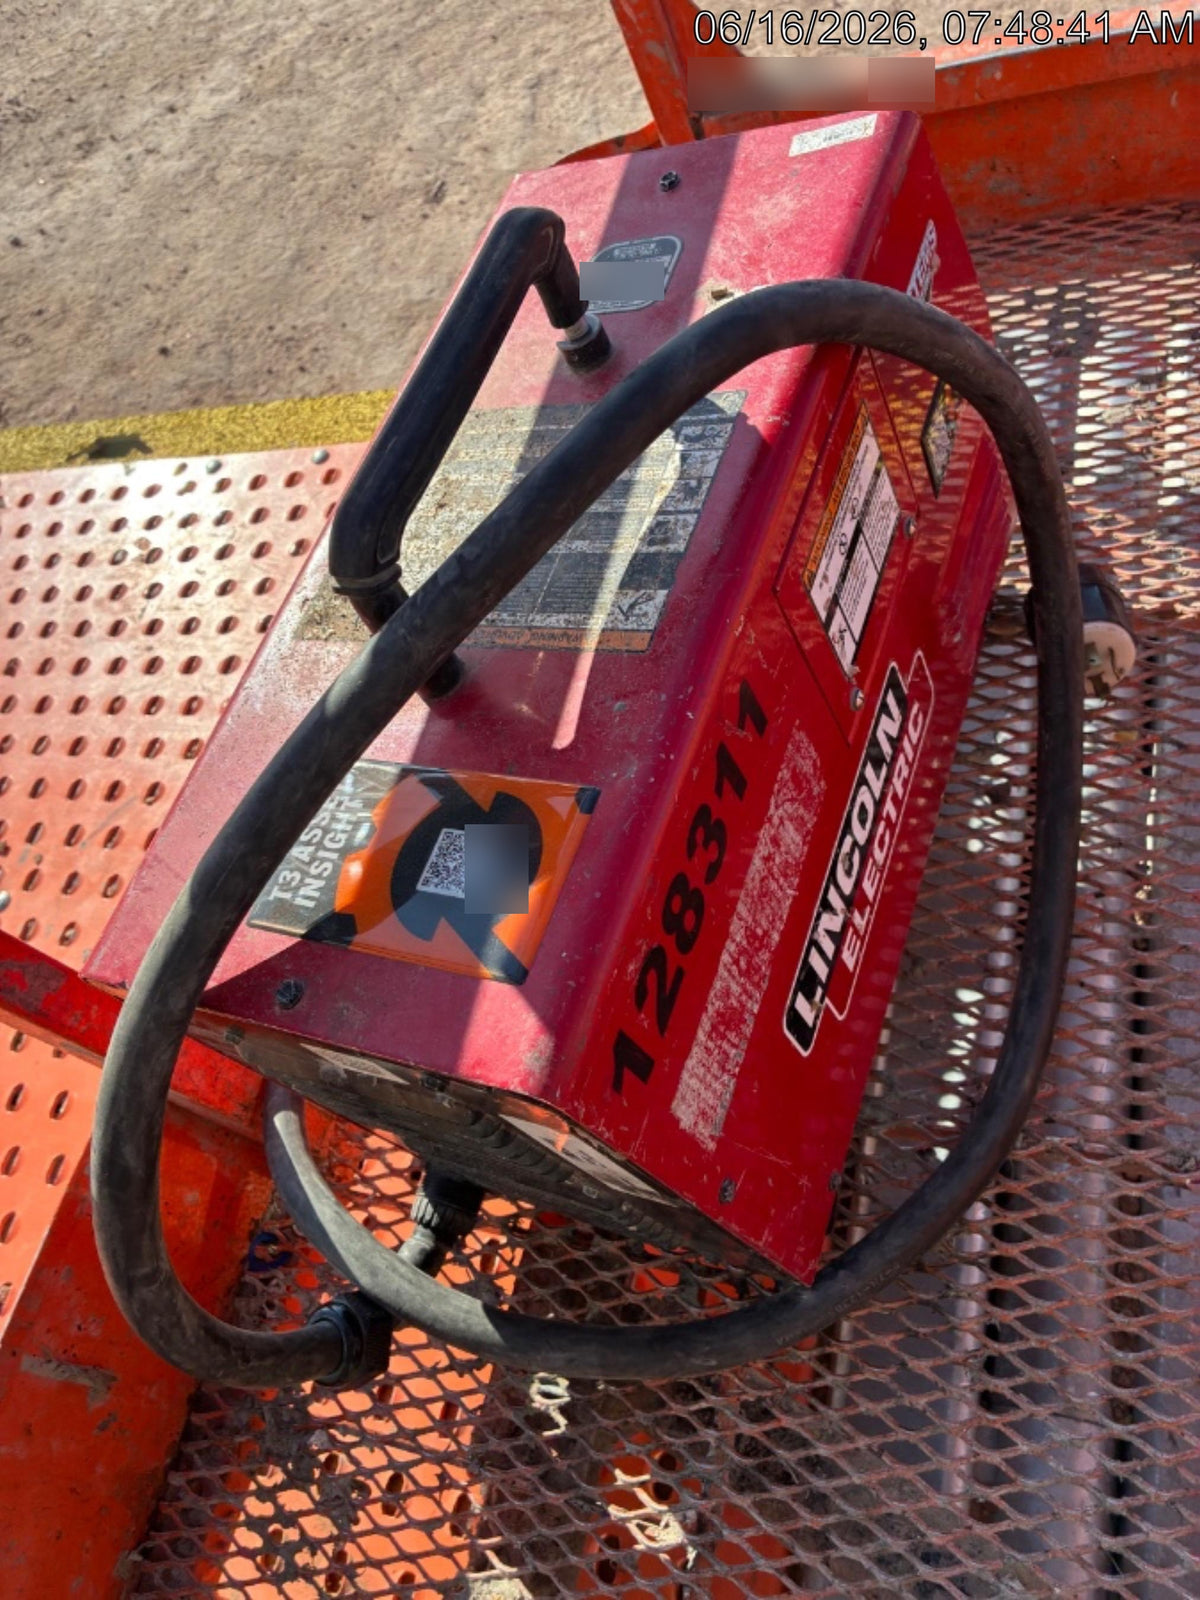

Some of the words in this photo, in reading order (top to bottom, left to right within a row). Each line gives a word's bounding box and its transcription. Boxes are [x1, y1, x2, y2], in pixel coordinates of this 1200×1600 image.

[268, 870, 301, 900] T3
[293, 796, 364, 908] INSIGHT
[611, 679, 769, 1094] 128311
[794, 689, 906, 1029] LINCOLN
[840, 701, 923, 973] ELECTRIC
